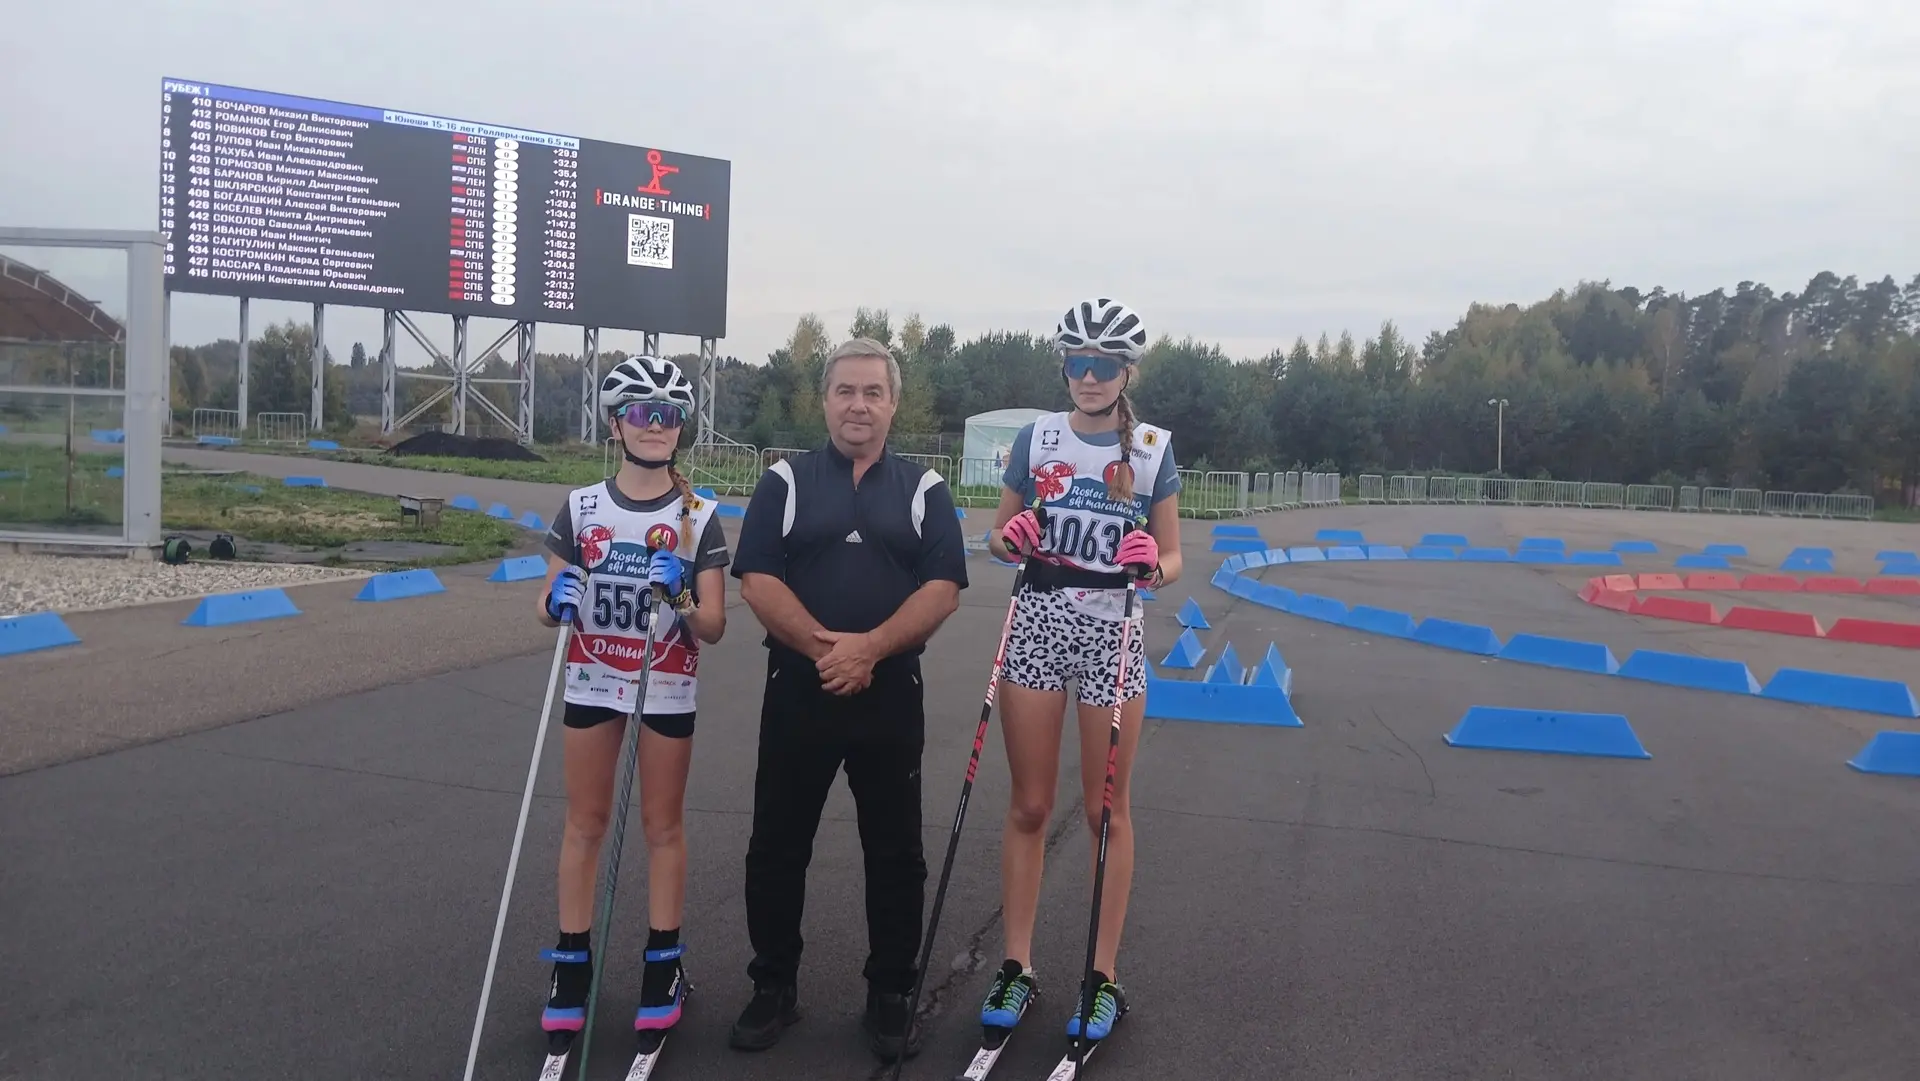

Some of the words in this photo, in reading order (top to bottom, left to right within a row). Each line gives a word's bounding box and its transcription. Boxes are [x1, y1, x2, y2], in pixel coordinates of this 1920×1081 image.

[164, 81, 201, 94] РУБЕЖ
[204, 87, 209, 96] 1
[163, 92, 171, 101] 5
[192, 96, 211, 107] 410
[215, 99, 266, 114] БОЧАРОВ
[269, 107, 308, 120] Михаил
[311, 113, 368, 129] Викторович
[467, 135, 486, 145] СПБ
[163, 103, 171, 112] 6
[192, 107, 211, 118] 412
[215, 111, 270, 126] РОМАНЮК
[274, 119, 295, 131] Егор
[298, 122, 352, 137] Денисович
[466, 146, 486, 156] ЛЕН
[394, 115, 428, 126] Юноши
[432, 120, 456, 130] 15-16
[547, 137, 561, 146] 6.5
[162, 138, 170, 147] 9
[189, 142, 210, 152] 443
[214, 145, 254, 158] РАХУБА
[257, 150, 282, 161] Иван
[286, 154, 363, 171] Александрович
[466, 177, 485, 187] ЛЕН
[550, 188, 576, 199] +1:17.1
[163, 115, 169, 124] 7
[190, 119, 211, 129] 405
[215, 122, 267, 137] НОВИКОВ
[270, 130, 292, 142] Егор
[295, 133, 353, 148] Викторович
[466, 156, 486, 166] СПБ
[553, 168, 577, 179] +35.4
[163, 126, 170, 136] 8
[190, 130, 210, 141] 401
[214, 133, 252, 146] ЛУПОВ
[255, 139, 280, 150] Иван
[284, 142, 345, 158] Михайлович
[466, 166, 485, 176] ЛЕН
[554, 179, 577, 189] +47.4
[162, 150, 176, 159] 10
[188, 153, 210, 163] 420
[214, 156, 272, 171] ТОРМОЗОВ
[276, 164, 314, 176] Михаил
[317, 169, 378, 184] Максимович
[466, 188, 485, 197] СПБ
[162, 161, 173, 170] 11
[214, 167, 263, 181] БАРАНОВ
[266, 174, 305, 186] Кирилл
[308, 179, 368, 194] Дмитриевич
[465, 198, 484, 208] ЛЕН
[162, 173, 175, 182] 12
[190, 176, 210, 186] 414
[214, 179, 282, 194] ШКЛЯРСКИЙ
[286, 187, 343, 202] Константин
[346, 194, 399, 208] Евгеньевич
[465, 208, 484, 218] ЛЕН
[161, 196, 174, 205] 14
[213, 201, 262, 214] КИСЕЛЕВ
[265, 207, 301, 219] Никита
[304, 211, 365, 226] Дмитриевич
[465, 229, 484, 239] СПБ
[545, 239, 576, 250] +1:52.2
[162, 184, 174, 194] 13
[187, 187, 209, 197] 409
[213, 190, 281, 206] БОГДАШКИН
[284, 198, 326, 211] Алексей
[329, 203, 386, 217] Викторович
[465, 219, 484, 228] СПБ
[544, 228, 576, 239] +1:50.0
[603, 191, 655, 210] ORANGE
[660, 199, 703, 217] TIMING
[161, 207, 174, 216] 15
[188, 210, 209, 220] 442
[213, 213, 265, 226] СОКОЛОВ
[268, 219, 311, 231] Савелий
[314, 224, 372, 237] Артемьевич
[465, 240, 484, 249] СПБ
[161, 218, 174, 228] 16
[189, 222, 209, 232] 413
[213, 224, 257, 236] ИВАНОВ
[260, 229, 285, 239] Иван
[289, 232, 330, 244] Никитич
[464, 250, 483, 259] ЛЕН
[164, 243, 174, 252] 8
[187, 244, 208, 254] 434
[212, 247, 285, 261] КОСТРОМКИН
[322, 257, 372, 270] Сергеевич
[464, 271, 483, 280] СПБ
[545, 279, 574, 290] +2:13.7
[188, 233, 209, 243] 424
[212, 235, 275, 249] САГИТУЛИН
[278, 242, 317, 253] Максим
[320, 246, 374, 259] Евгеньевич
[464, 261, 483, 270] СПБ
[545, 269, 574, 280] +2:11.2
[188, 256, 208, 265] 427
[212, 258, 260, 270] ВАССАРА
[264, 263, 320, 276] Владислав
[322, 268, 366, 280] Юрьевич
[464, 281, 483, 290] СПБ
[188, 267, 208, 277] 416
[212, 269, 265, 282] ПОЛУНИН
[268, 274, 326, 287] Константин
[328, 280, 404, 294] Александрович
[464, 292, 483, 301] СПБ
[543, 300, 574, 310] +2:31.4
[1069, 496, 1084, 510] ski
[1086, 498, 1134, 516] marathon
[1072, 486, 1104, 500] Rostec
[610, 550, 648, 564] Rostec
[1043, 514, 1122, 568] 1063
[608, 560, 624, 574] ski
[592, 582, 652, 634] 558
[660, 949, 682, 958] SPIN
